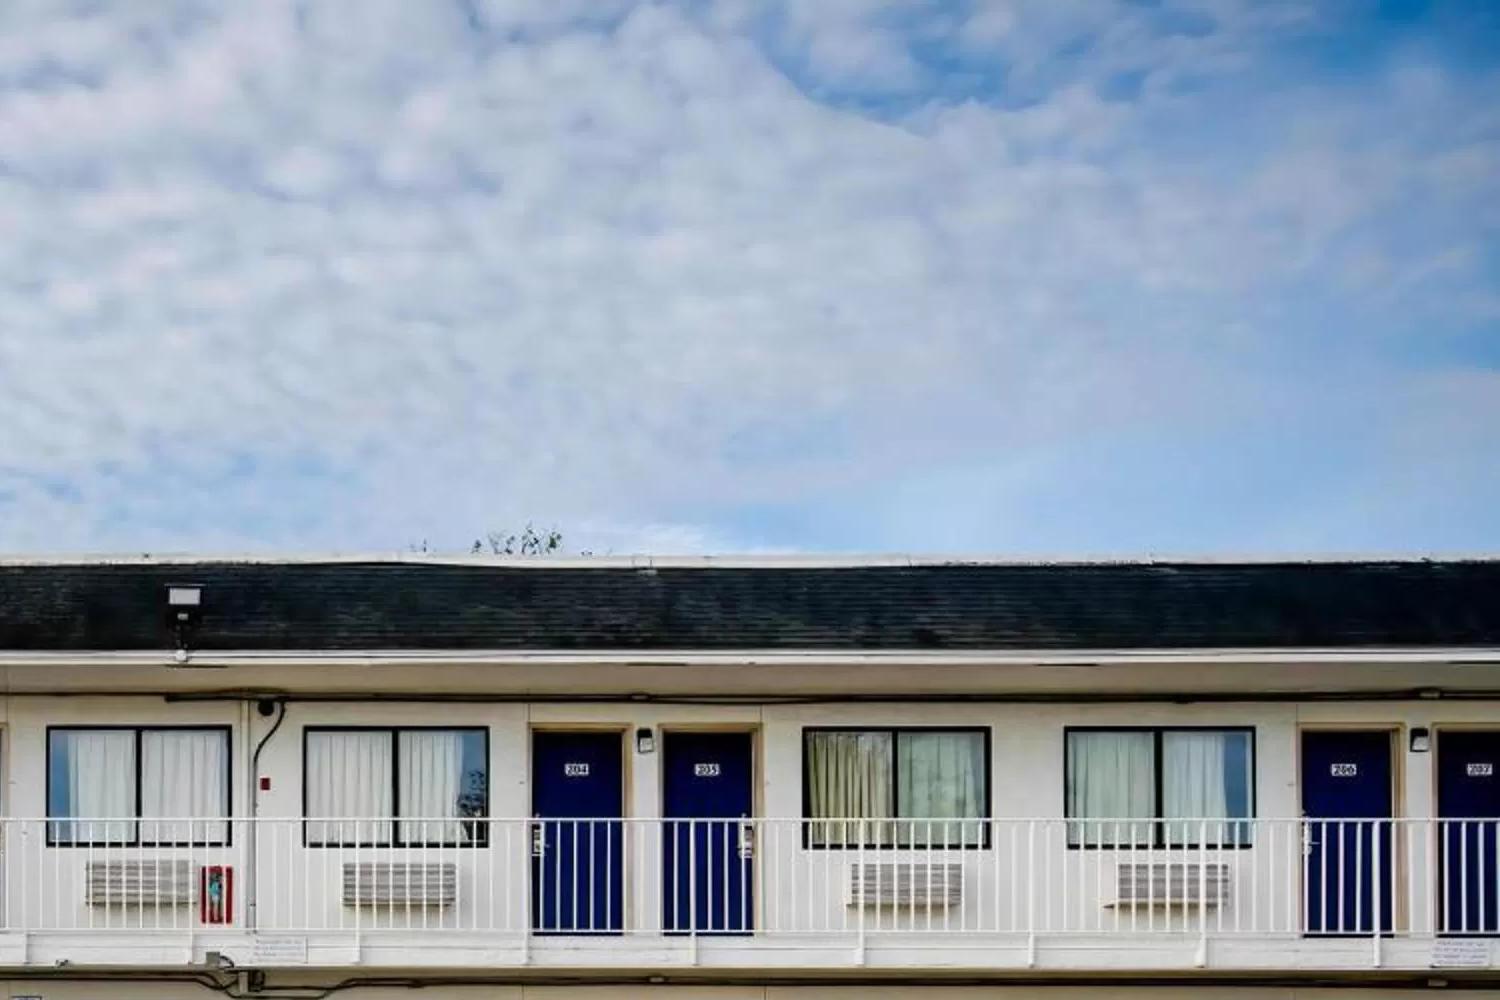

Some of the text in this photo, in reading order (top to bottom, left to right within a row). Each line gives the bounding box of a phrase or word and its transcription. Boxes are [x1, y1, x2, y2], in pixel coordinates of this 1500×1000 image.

[567, 764, 587, 775] 204
[697, 764, 717, 775] 205
[1333, 764, 1355, 775] 206
